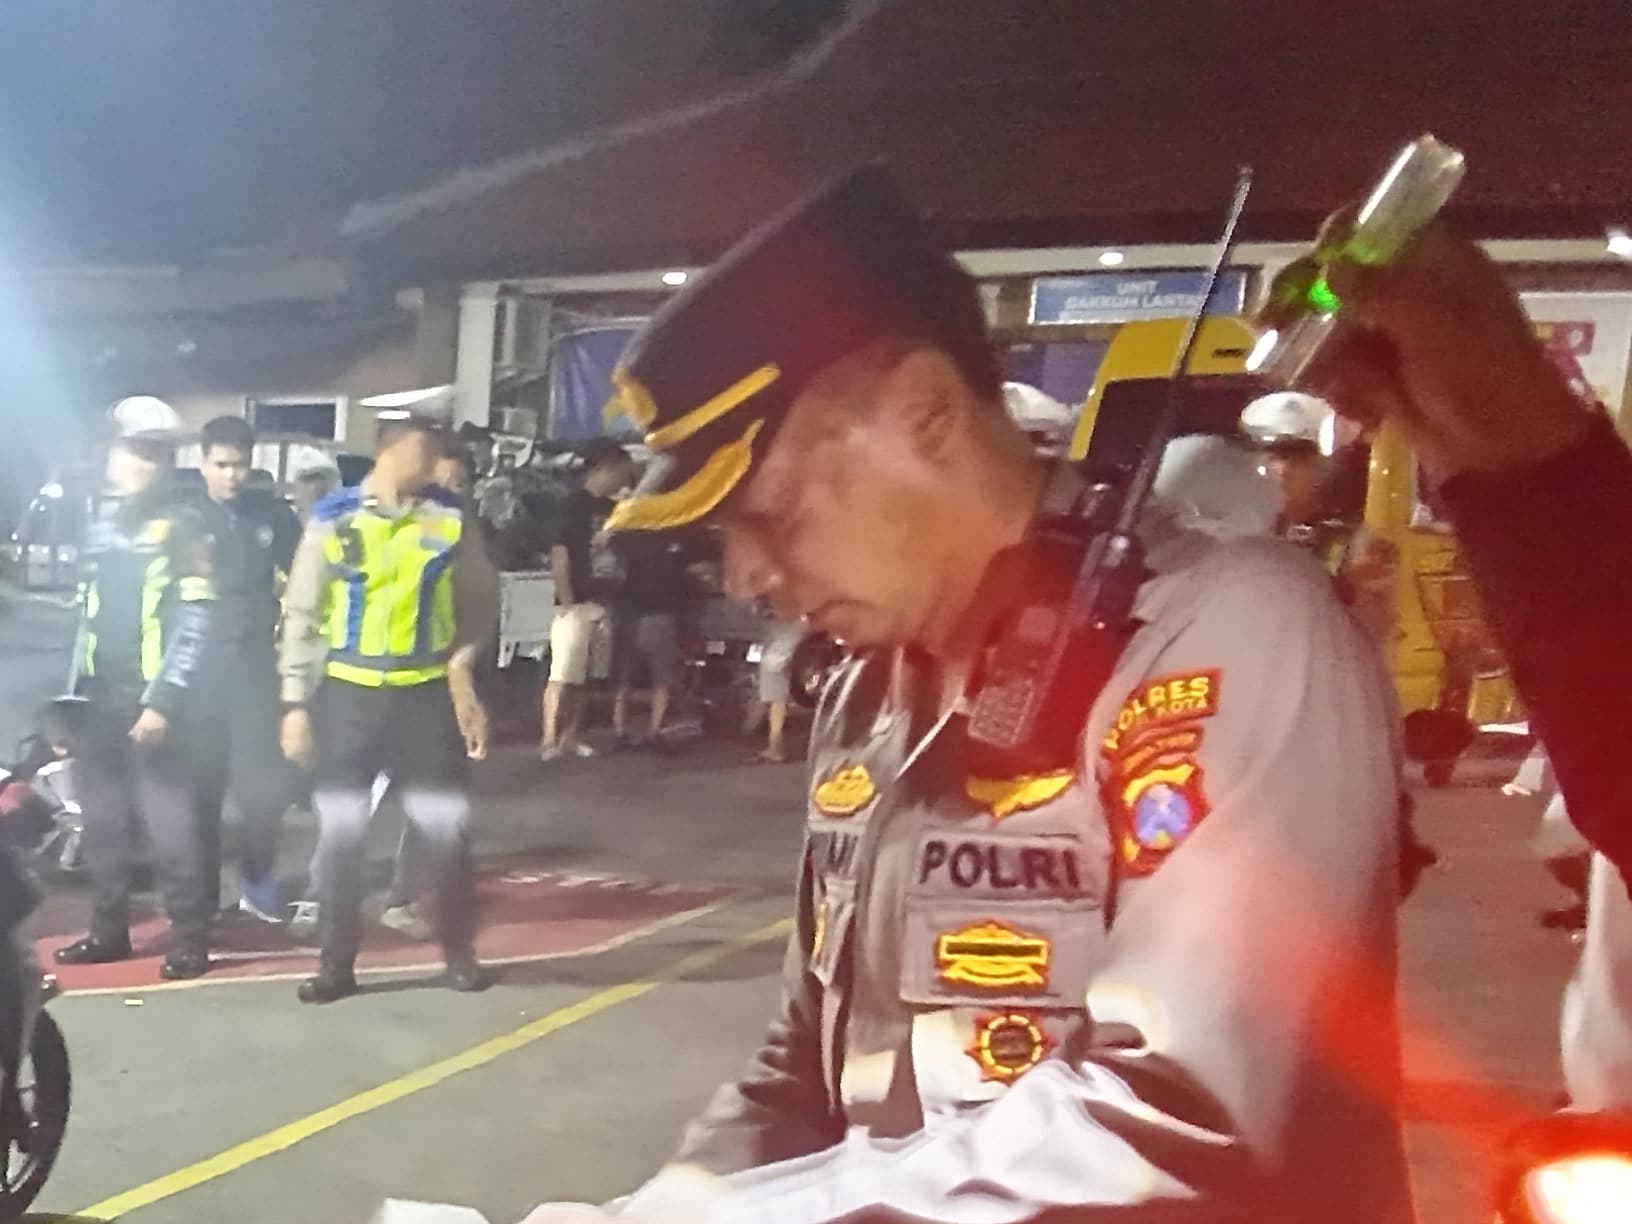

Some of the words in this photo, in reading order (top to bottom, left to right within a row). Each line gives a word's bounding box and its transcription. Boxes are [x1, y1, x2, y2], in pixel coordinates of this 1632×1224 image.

[1117, 280, 1158, 295] UNIT
[1103, 677, 1209, 750] POLRES
[919, 841, 1081, 889] POLRI
